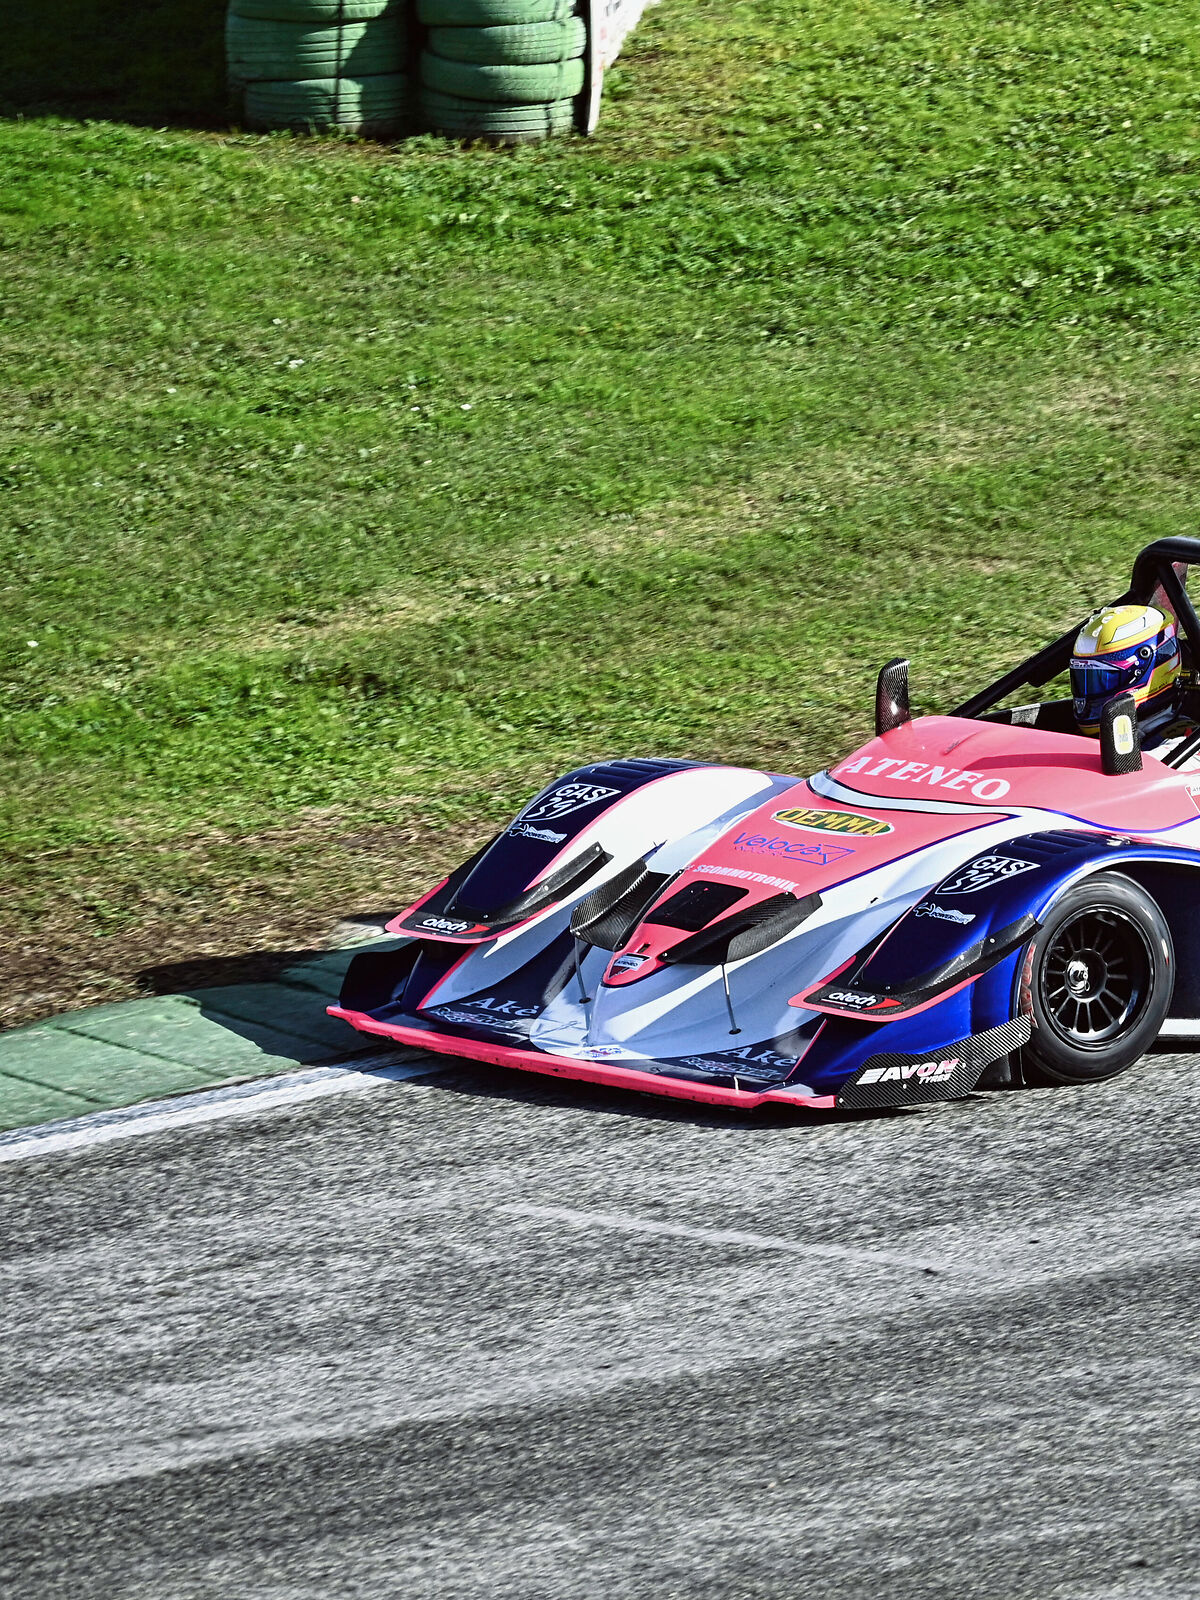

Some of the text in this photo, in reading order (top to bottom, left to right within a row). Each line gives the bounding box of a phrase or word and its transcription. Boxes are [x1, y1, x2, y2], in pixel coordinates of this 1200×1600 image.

[837, 756, 1011, 800] ATENEO
[555, 785, 607, 801] GAS
[525, 797, 577, 818] 39
[972, 857, 1026, 875] GAS
[941, 869, 994, 891] 39
[879, 1058, 960, 1083] AVON
[918, 1073, 952, 1085] TYRES
